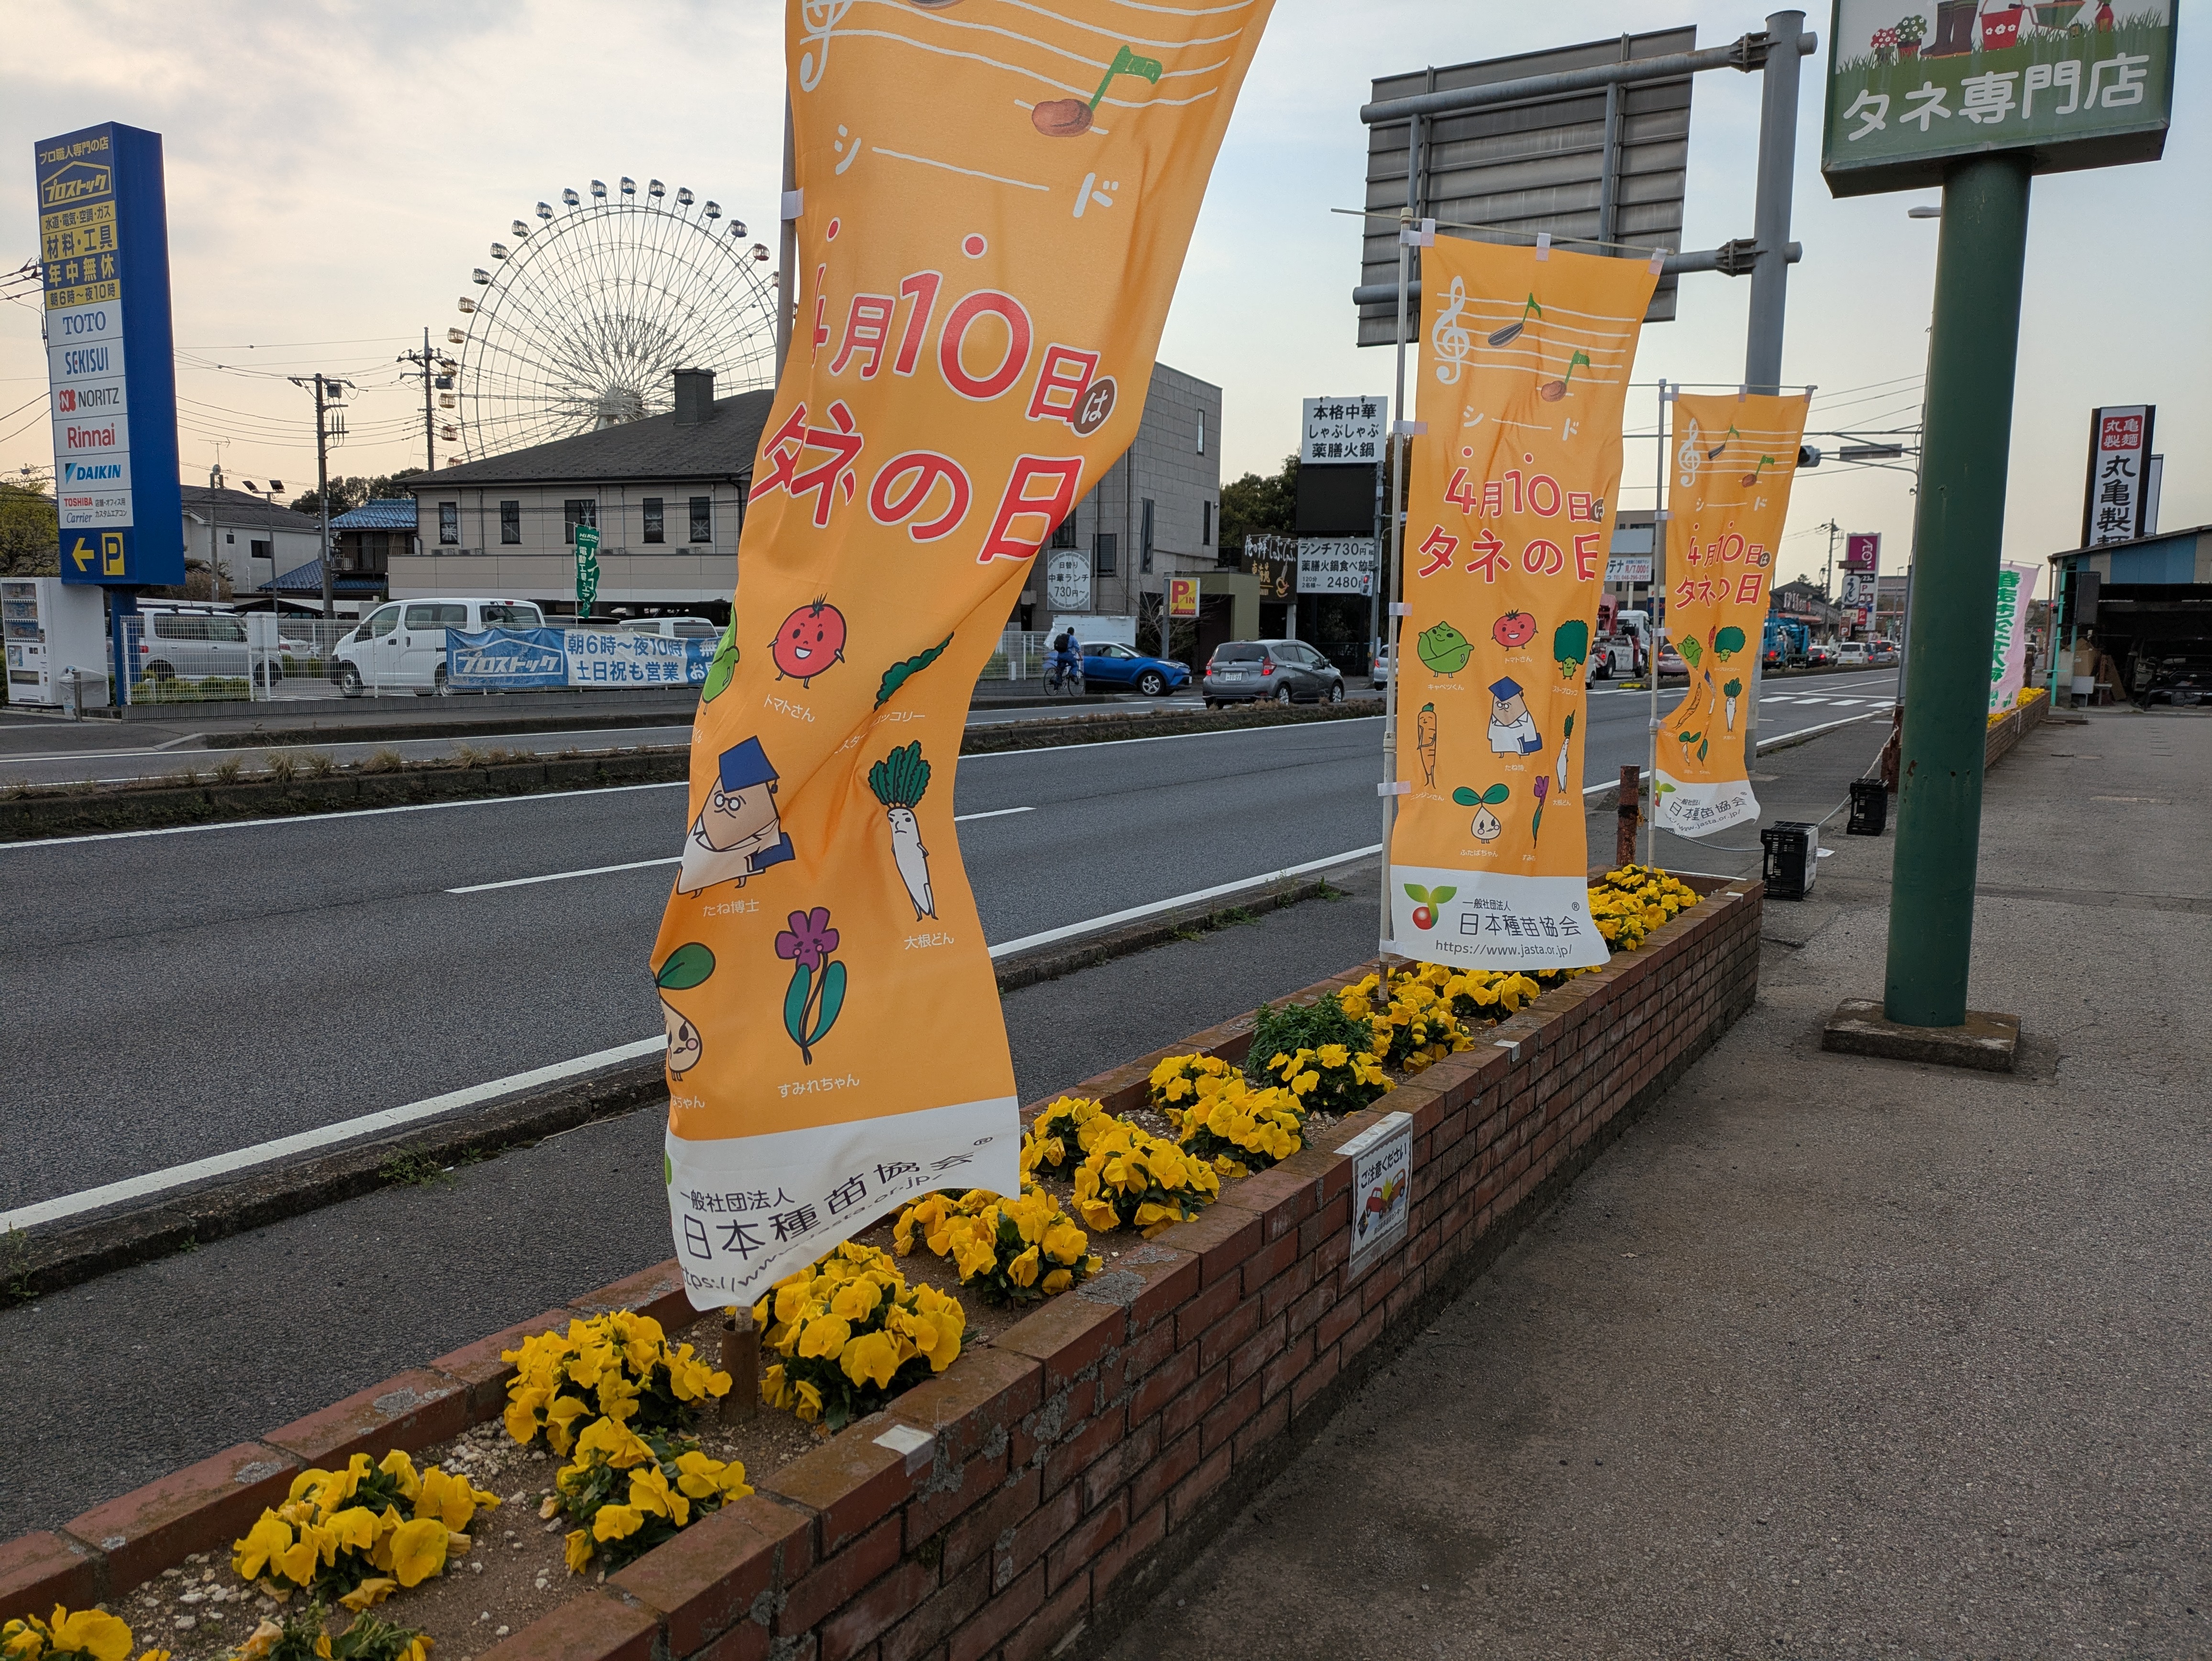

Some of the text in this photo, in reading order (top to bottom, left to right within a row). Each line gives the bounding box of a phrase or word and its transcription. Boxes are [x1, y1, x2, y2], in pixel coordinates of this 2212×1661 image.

[1843, 52, 2150, 142] タネ専門店
[39, 136, 109, 165] プロ職人専門の店
[45, 174, 107, 202] プロストック
[45, 205, 111, 230] 水道・電気・空調・ガス
[46, 224, 113, 259] 材料・工具
[48, 254, 114, 287] 年中無休
[63, 311, 106, 334] TOTO
[65, 347, 109, 376] SEKISUI
[78, 387, 120, 408] NORITZ
[1313, 404, 1377, 420] 本格中華
[67, 422, 116, 449] Rinnai
[1309, 424, 1379, 439] しゃぶしゃぶ
[2106, 419, 2139, 433] 丸亀
[1312, 442, 1375, 458] 薬膳火鍋
[76, 464, 121, 481] DAIKIN
[64, 497, 93, 507] TOSHIBA
[95, 498, 126, 507] 店舗・オフィス用
[66, 512, 92, 523] Carrier
[95, 509, 127, 518] カスタムエアコン
[1418, 524, 1600, 584] タネの日
[1048, 574, 1089, 582] 中華ランチ
[1327, 576, 1361, 588] 2480
[1172, 580, 1189, 603] P
[457, 650, 559, 674] プロストック
[1505, 655, 1533, 664] トマトさん
[576, 660, 680, 682] 土日祝も営業
[764, 694, 815, 723] トマトさん
[1410, 792, 1445, 801] ニンジンさん
[1460, 849, 1498, 858] ふたばちゃん
[702, 899, 760, 917] たね博士
[1462, 897, 1512, 912] 一般社団法人
[1460, 912, 1582, 938] 日本種苗協会
[903, 932, 954, 950] 大根どん
[1435, 939, 1573, 958] https://www.jasta.or.jp/
[777, 1074, 860, 1098] すみれちゃん
[1360, 1142, 1407, 1189] ご注意ください
[680, 1186, 796, 1213] 一般社団法人
[684, 1152, 974, 1261] 日本種苗協会
